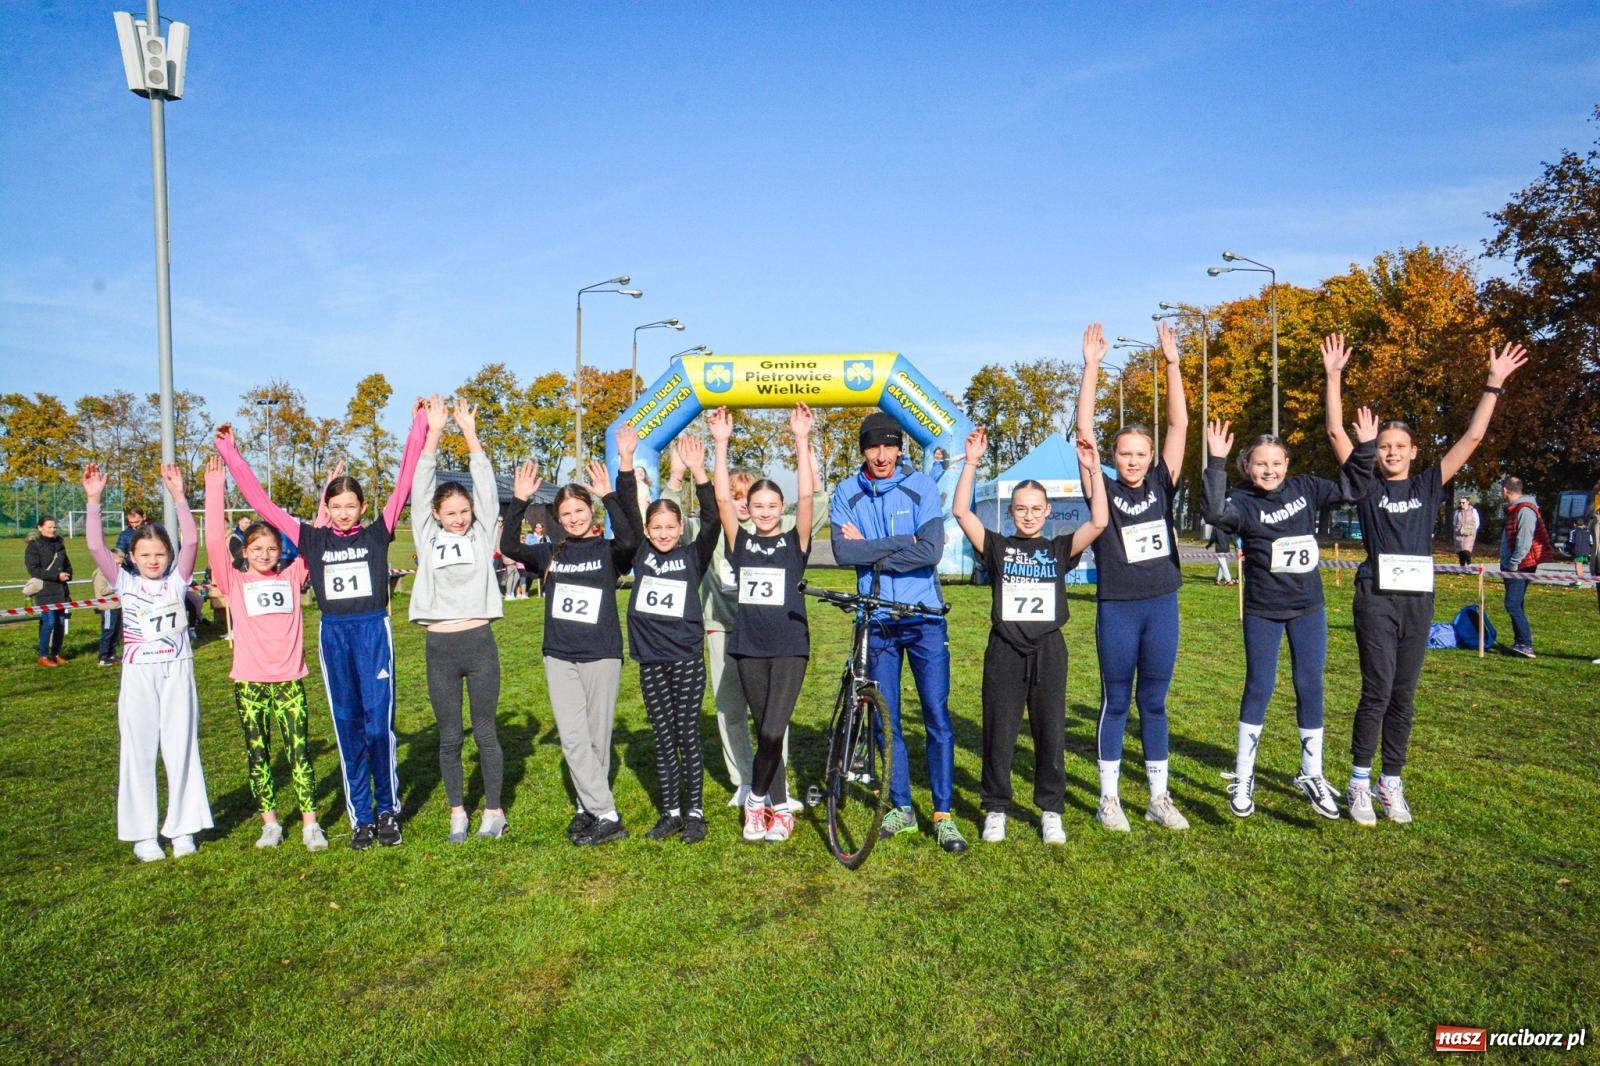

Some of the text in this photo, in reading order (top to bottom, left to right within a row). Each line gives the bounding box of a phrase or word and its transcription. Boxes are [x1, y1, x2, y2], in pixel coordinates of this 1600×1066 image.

[760, 360, 817, 369] Gmina
[745, 371, 832, 382] Pietrowice
[654, 372, 682, 401] ludzi
[756, 383, 821, 395] Wielkie
[897, 371, 957, 427] Gmina ludzi
[637, 387, 692, 440] aktywnych
[887, 384, 942, 437] aktywnych
[436, 543, 462, 560] 71
[1283, 549, 1310, 566] 78
[1003, 562, 1057, 578] HANDBALL
[332, 574, 358, 592] 81
[747, 581, 774, 598] 73
[257, 591, 285, 608] 69
[562, 597, 589, 615] 82
[646, 590, 674, 609] 64
[1014, 596, 1044, 614] 72
[149, 611, 177, 632] 77
